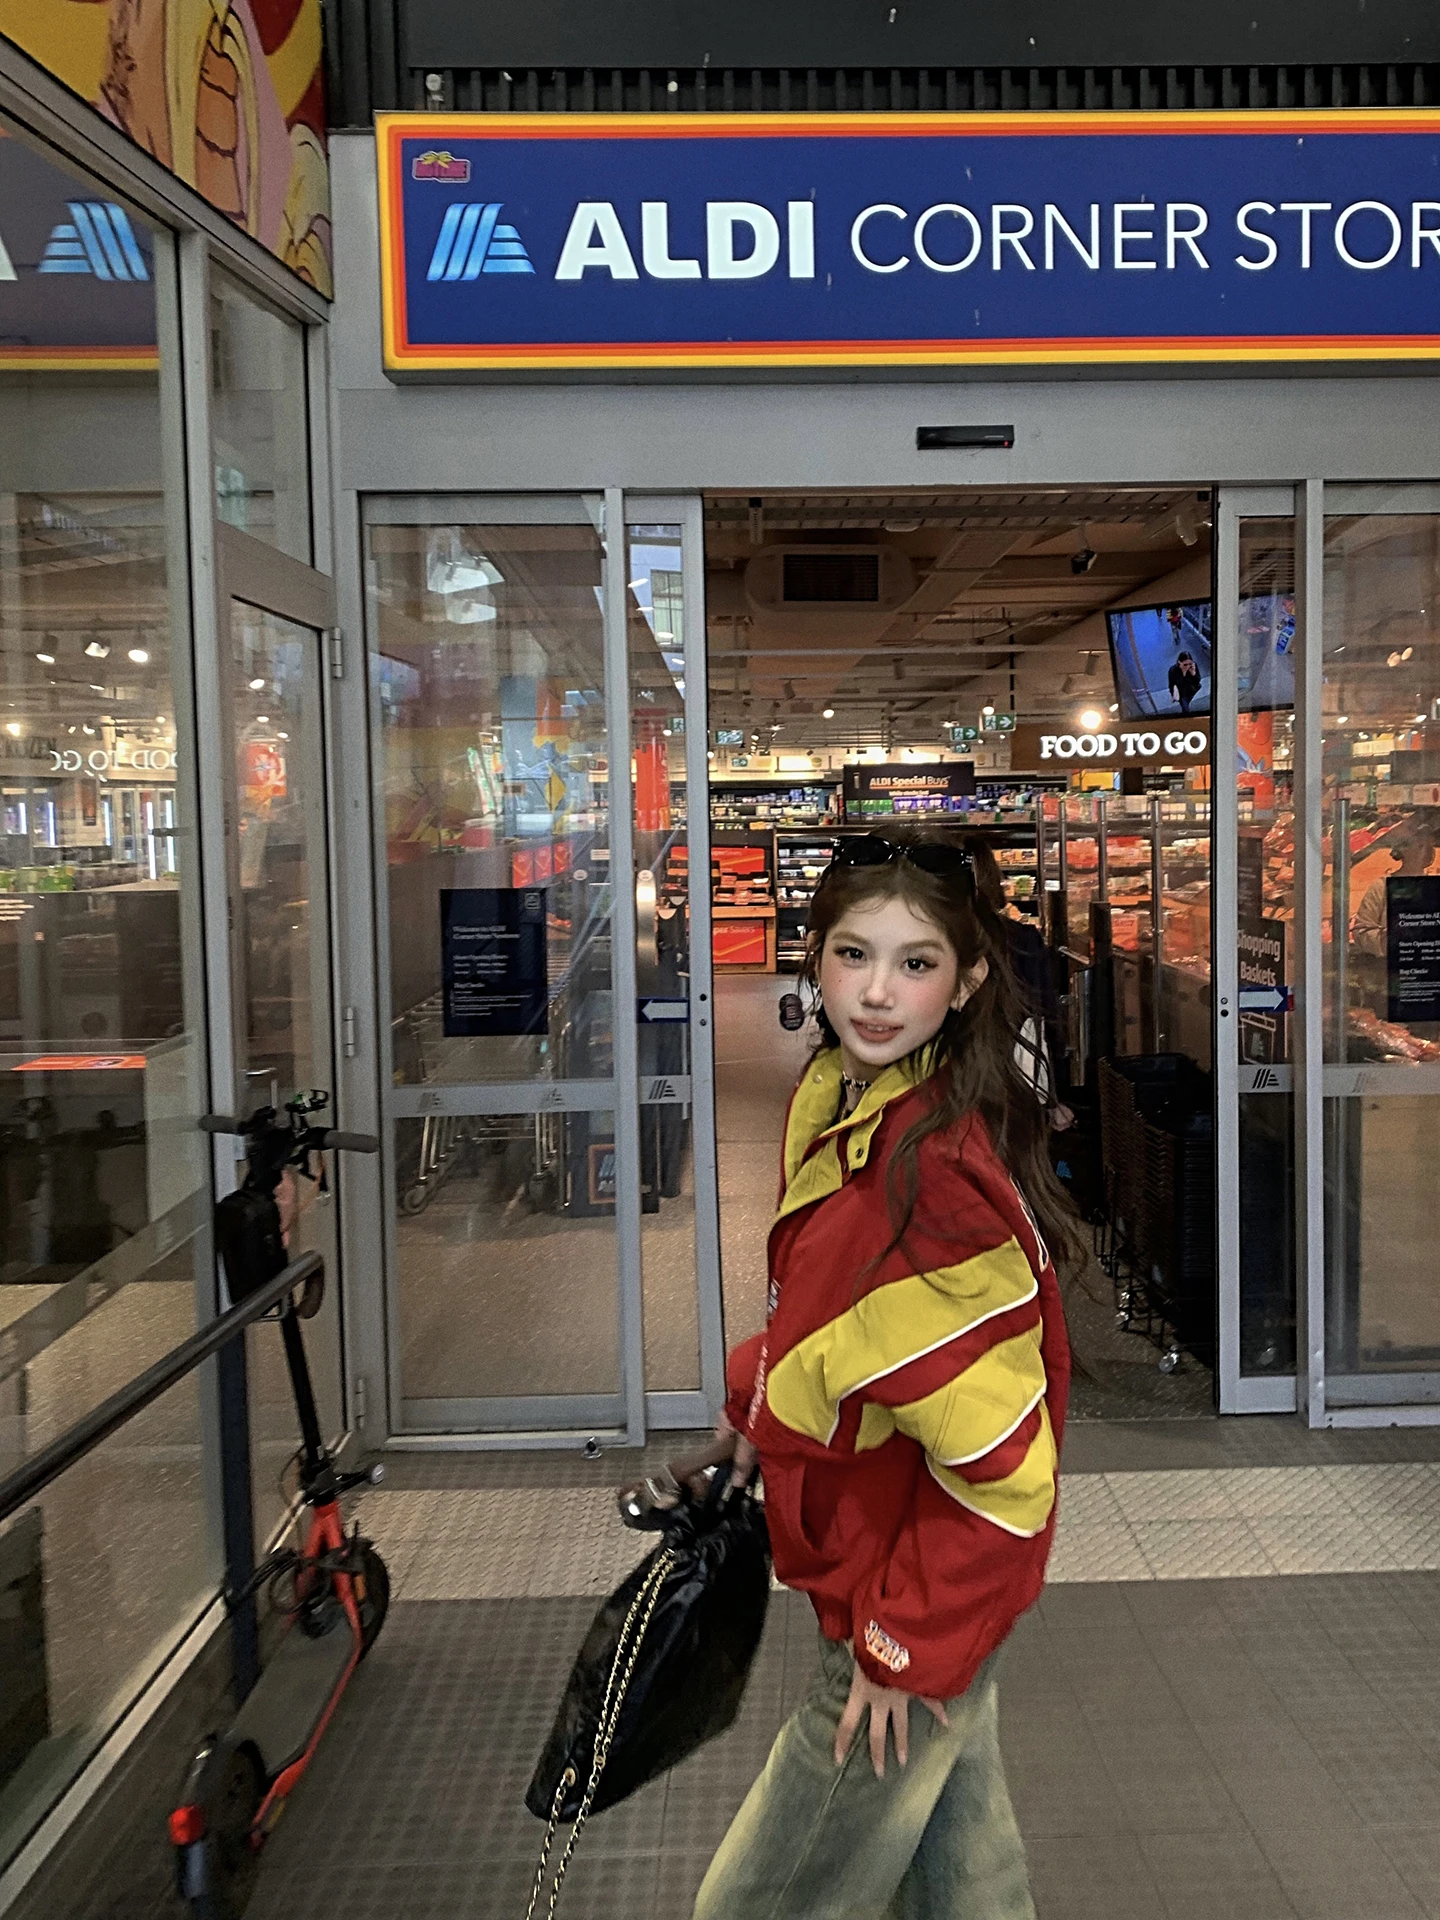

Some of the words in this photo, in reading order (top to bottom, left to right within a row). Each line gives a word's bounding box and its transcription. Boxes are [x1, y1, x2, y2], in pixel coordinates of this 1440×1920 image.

[555, 200, 815, 281] ALDI
[850, 201, 1210, 275] CORNER
[1040, 734, 1116, 760] FOOD
[1120, 732, 1161, 756] TO
[1164, 730, 1207, 755] GO
[869, 777, 891, 787] ALDI
[892, 775, 926, 787] Special
[927, 776, 949, 786] Buys
[1240, 960, 1276, 987] Baskets
